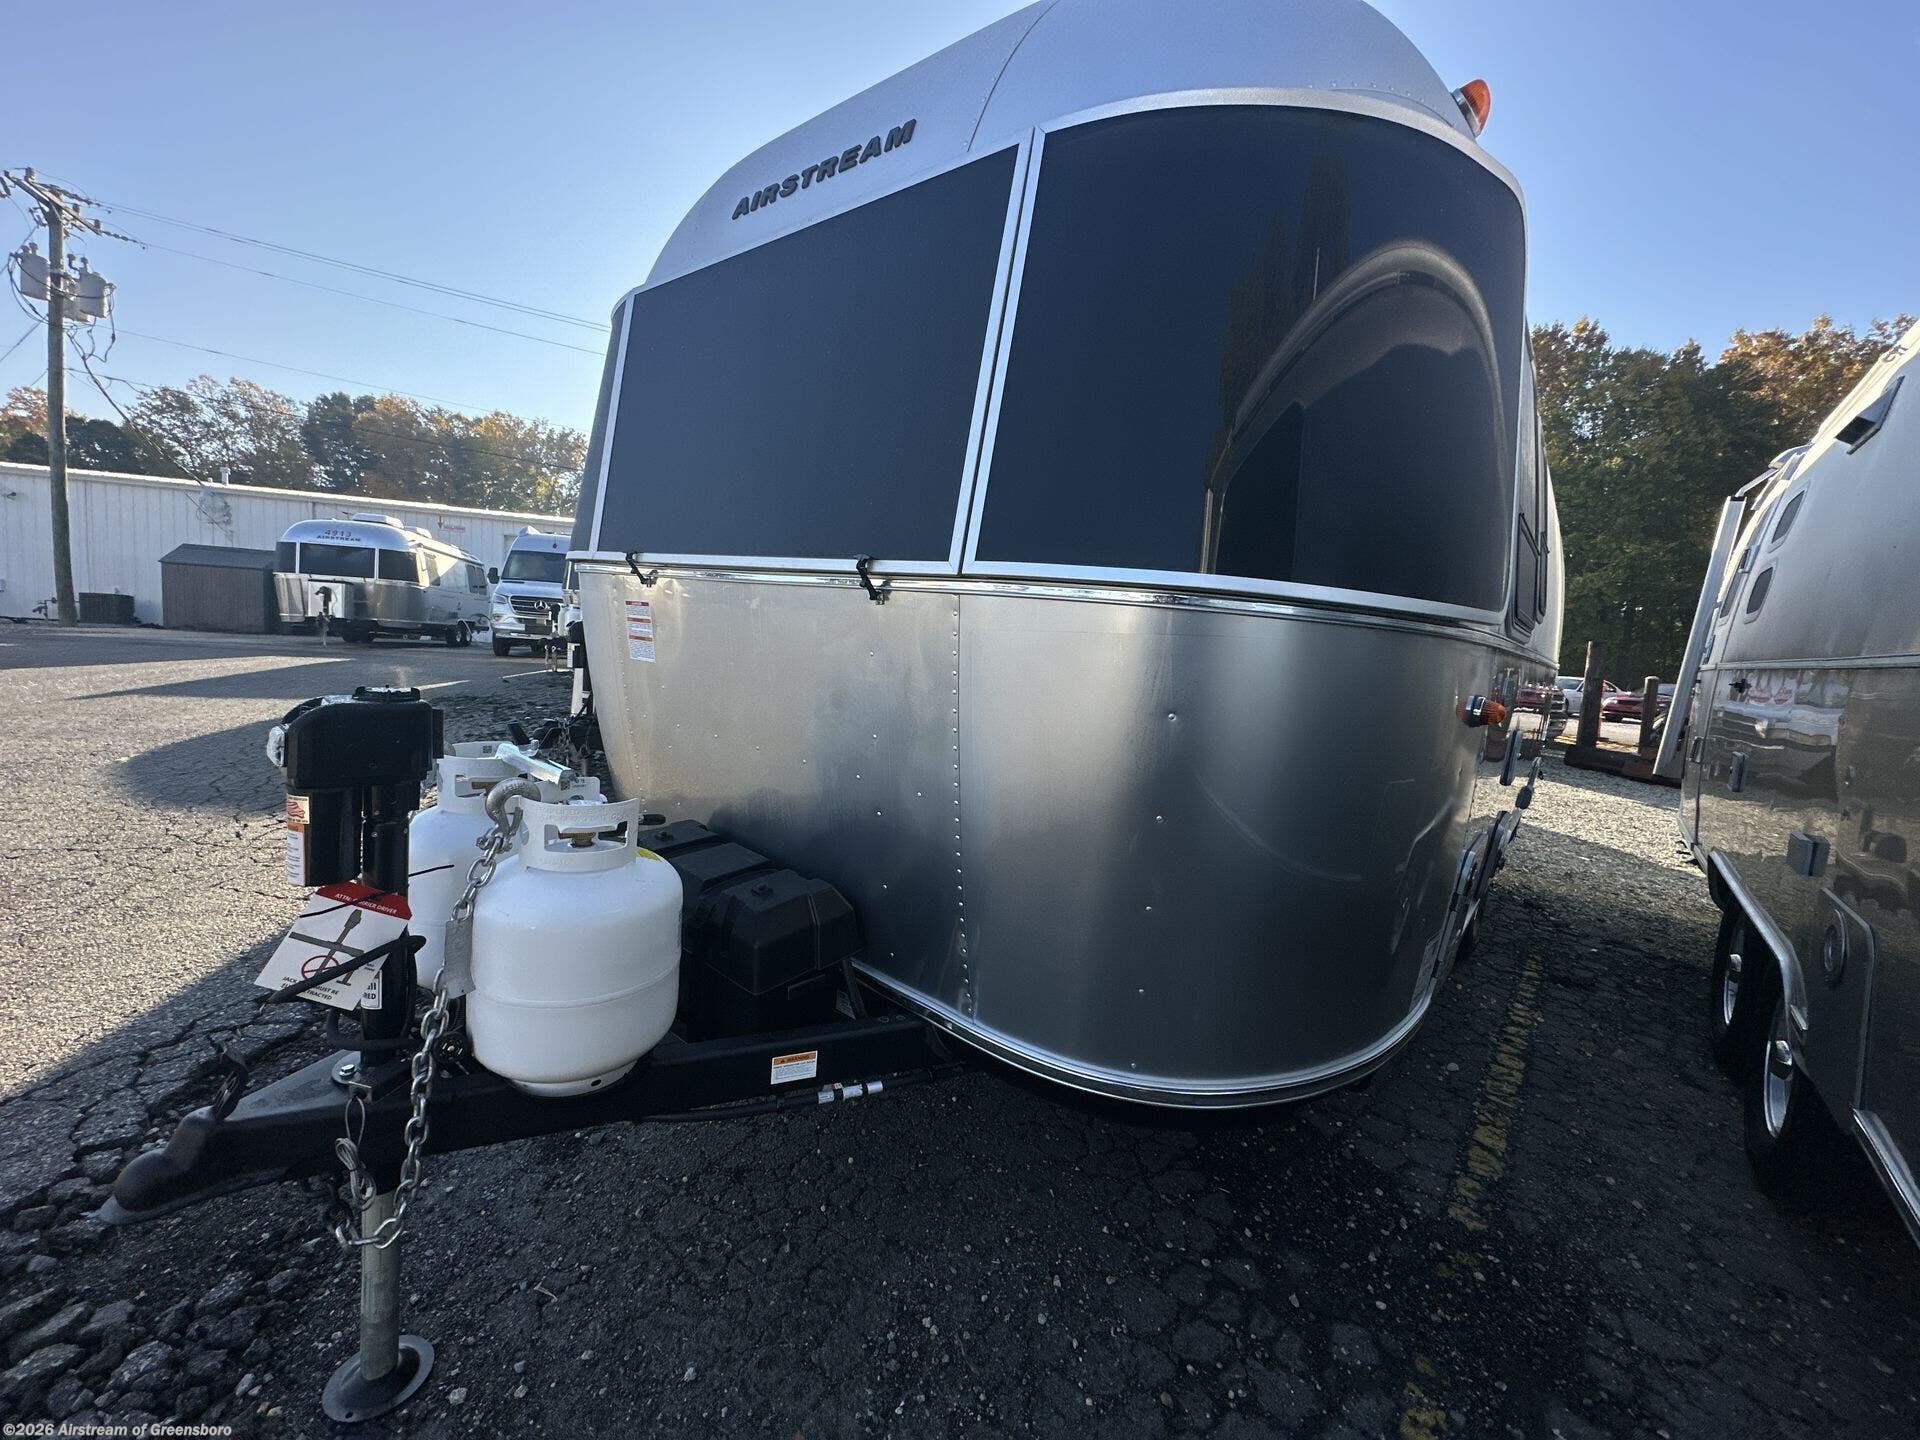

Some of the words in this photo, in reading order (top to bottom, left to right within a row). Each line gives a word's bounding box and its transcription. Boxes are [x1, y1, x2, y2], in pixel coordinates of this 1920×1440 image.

[731, 118, 917, 221] AIRSTREAM
[377, 905, 397, 913] DRIVER
[307, 990, 332, 999] TRACTED
